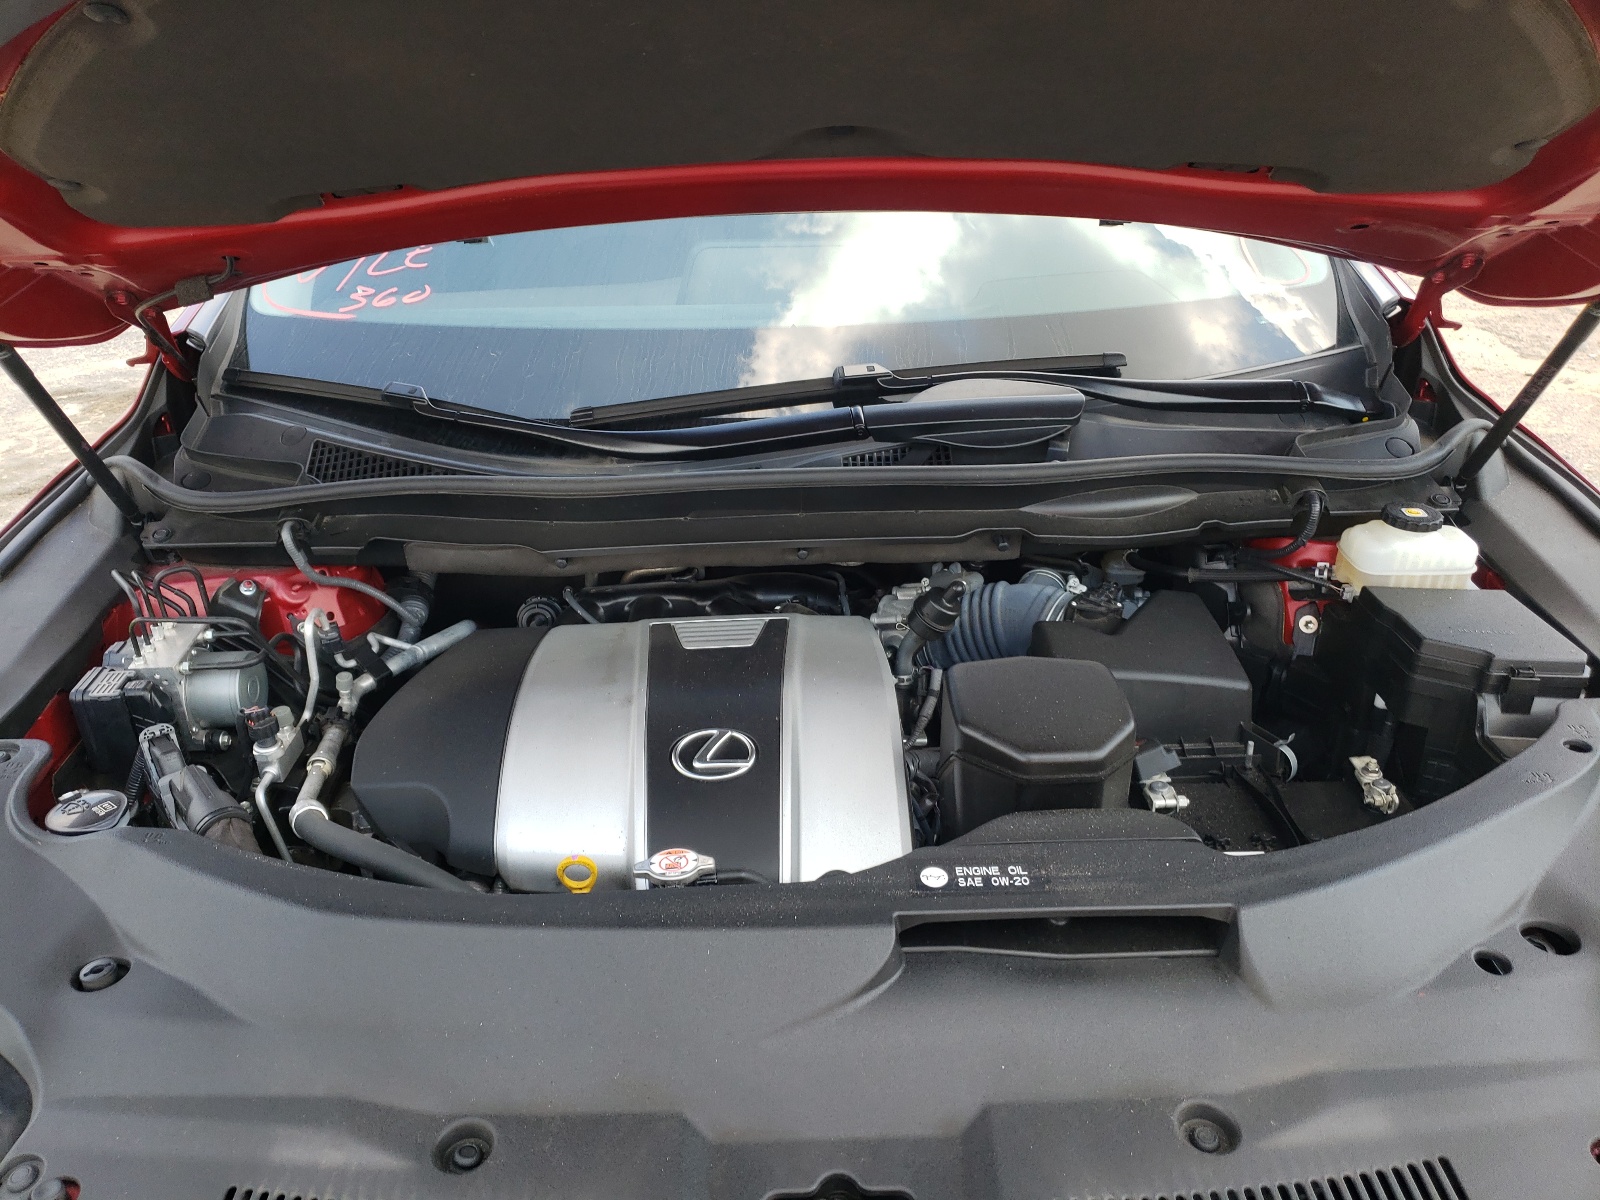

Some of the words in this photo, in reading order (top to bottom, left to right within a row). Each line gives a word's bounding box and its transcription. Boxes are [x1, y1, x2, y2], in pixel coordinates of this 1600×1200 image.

[339, 284, 432, 313] 360
[955, 866, 1000, 876] ENGINE
[1008, 866, 1028, 875] OIL
[958, 877, 983, 887] SAE
[991, 876, 1030, 886] 0W-20
